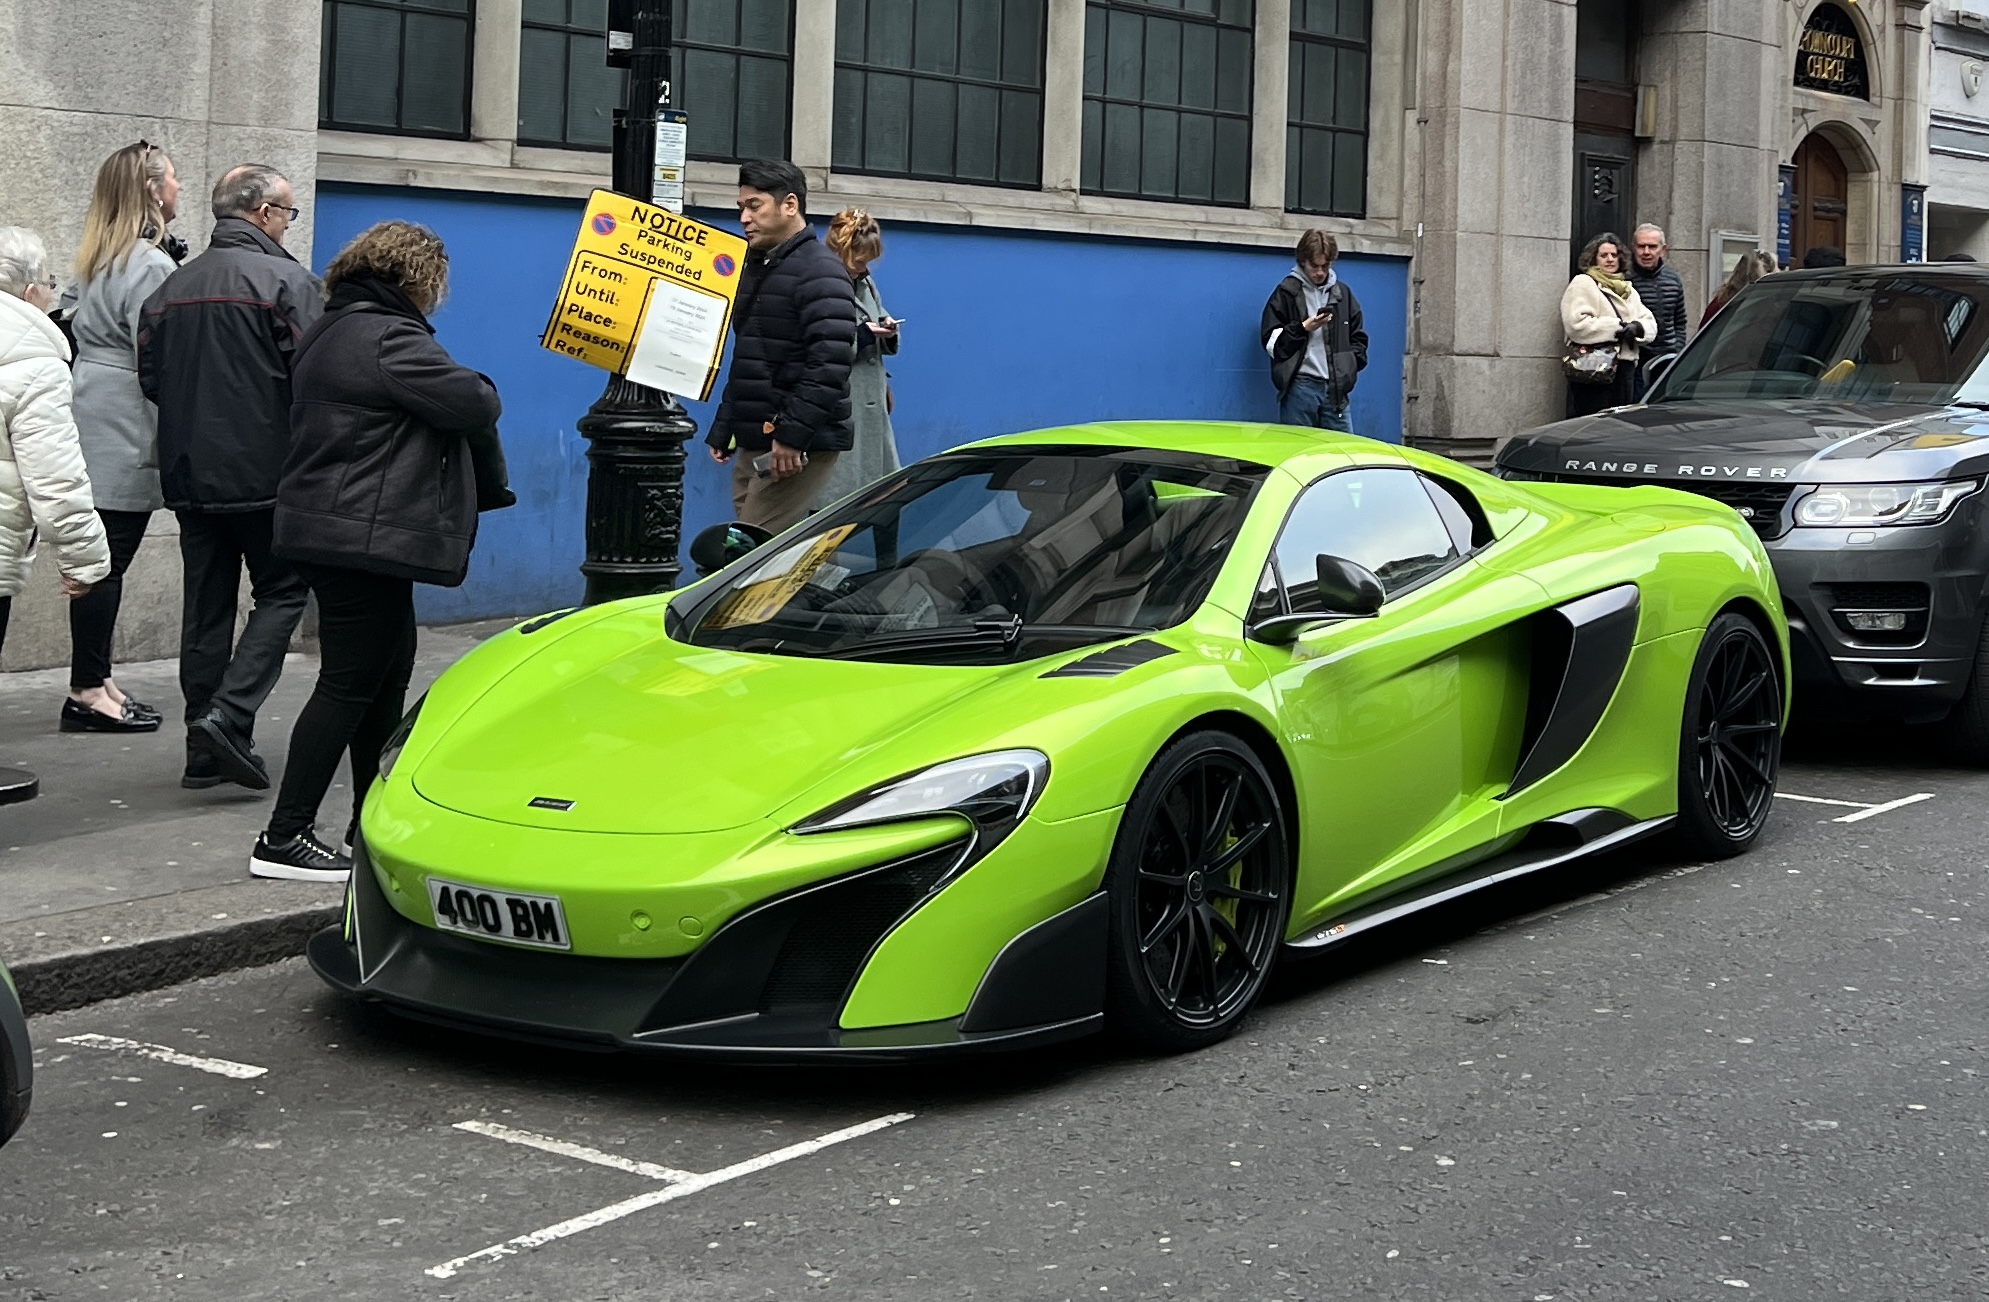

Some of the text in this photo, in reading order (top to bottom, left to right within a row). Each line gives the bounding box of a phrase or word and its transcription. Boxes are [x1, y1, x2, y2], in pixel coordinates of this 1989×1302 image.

[630, 206, 708, 247] NOTICE
[637, 229, 692, 261] Parking
[580, 260, 628, 285] From:
[617, 242, 702, 281] Suspended
[575, 281, 620, 306] Until:
[567, 303, 617, 329] Place:
[554, 339, 588, 360] Ref:
[560, 323, 626, 353] Reason:
[1565, 460, 1787, 478] RANGE ROVER
[438, 886, 560, 942] 400 BM
